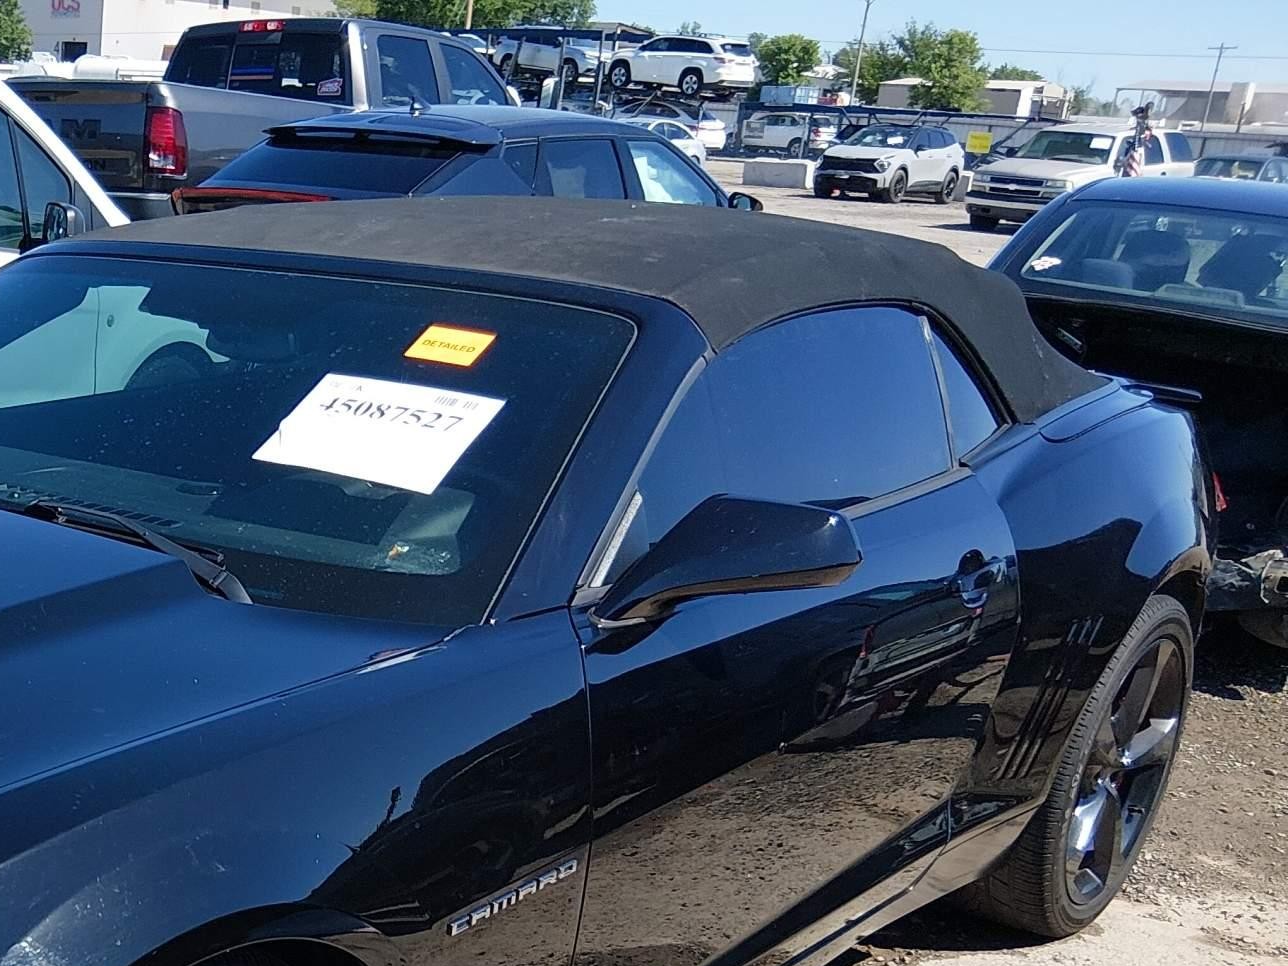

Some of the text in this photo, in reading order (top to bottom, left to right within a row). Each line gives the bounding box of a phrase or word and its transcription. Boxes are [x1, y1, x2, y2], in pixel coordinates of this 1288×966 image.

[422, 338, 476, 354] DETAILED
[319, 396, 464, 431] 45087527
[446, 858, 578, 937] CAMARO
